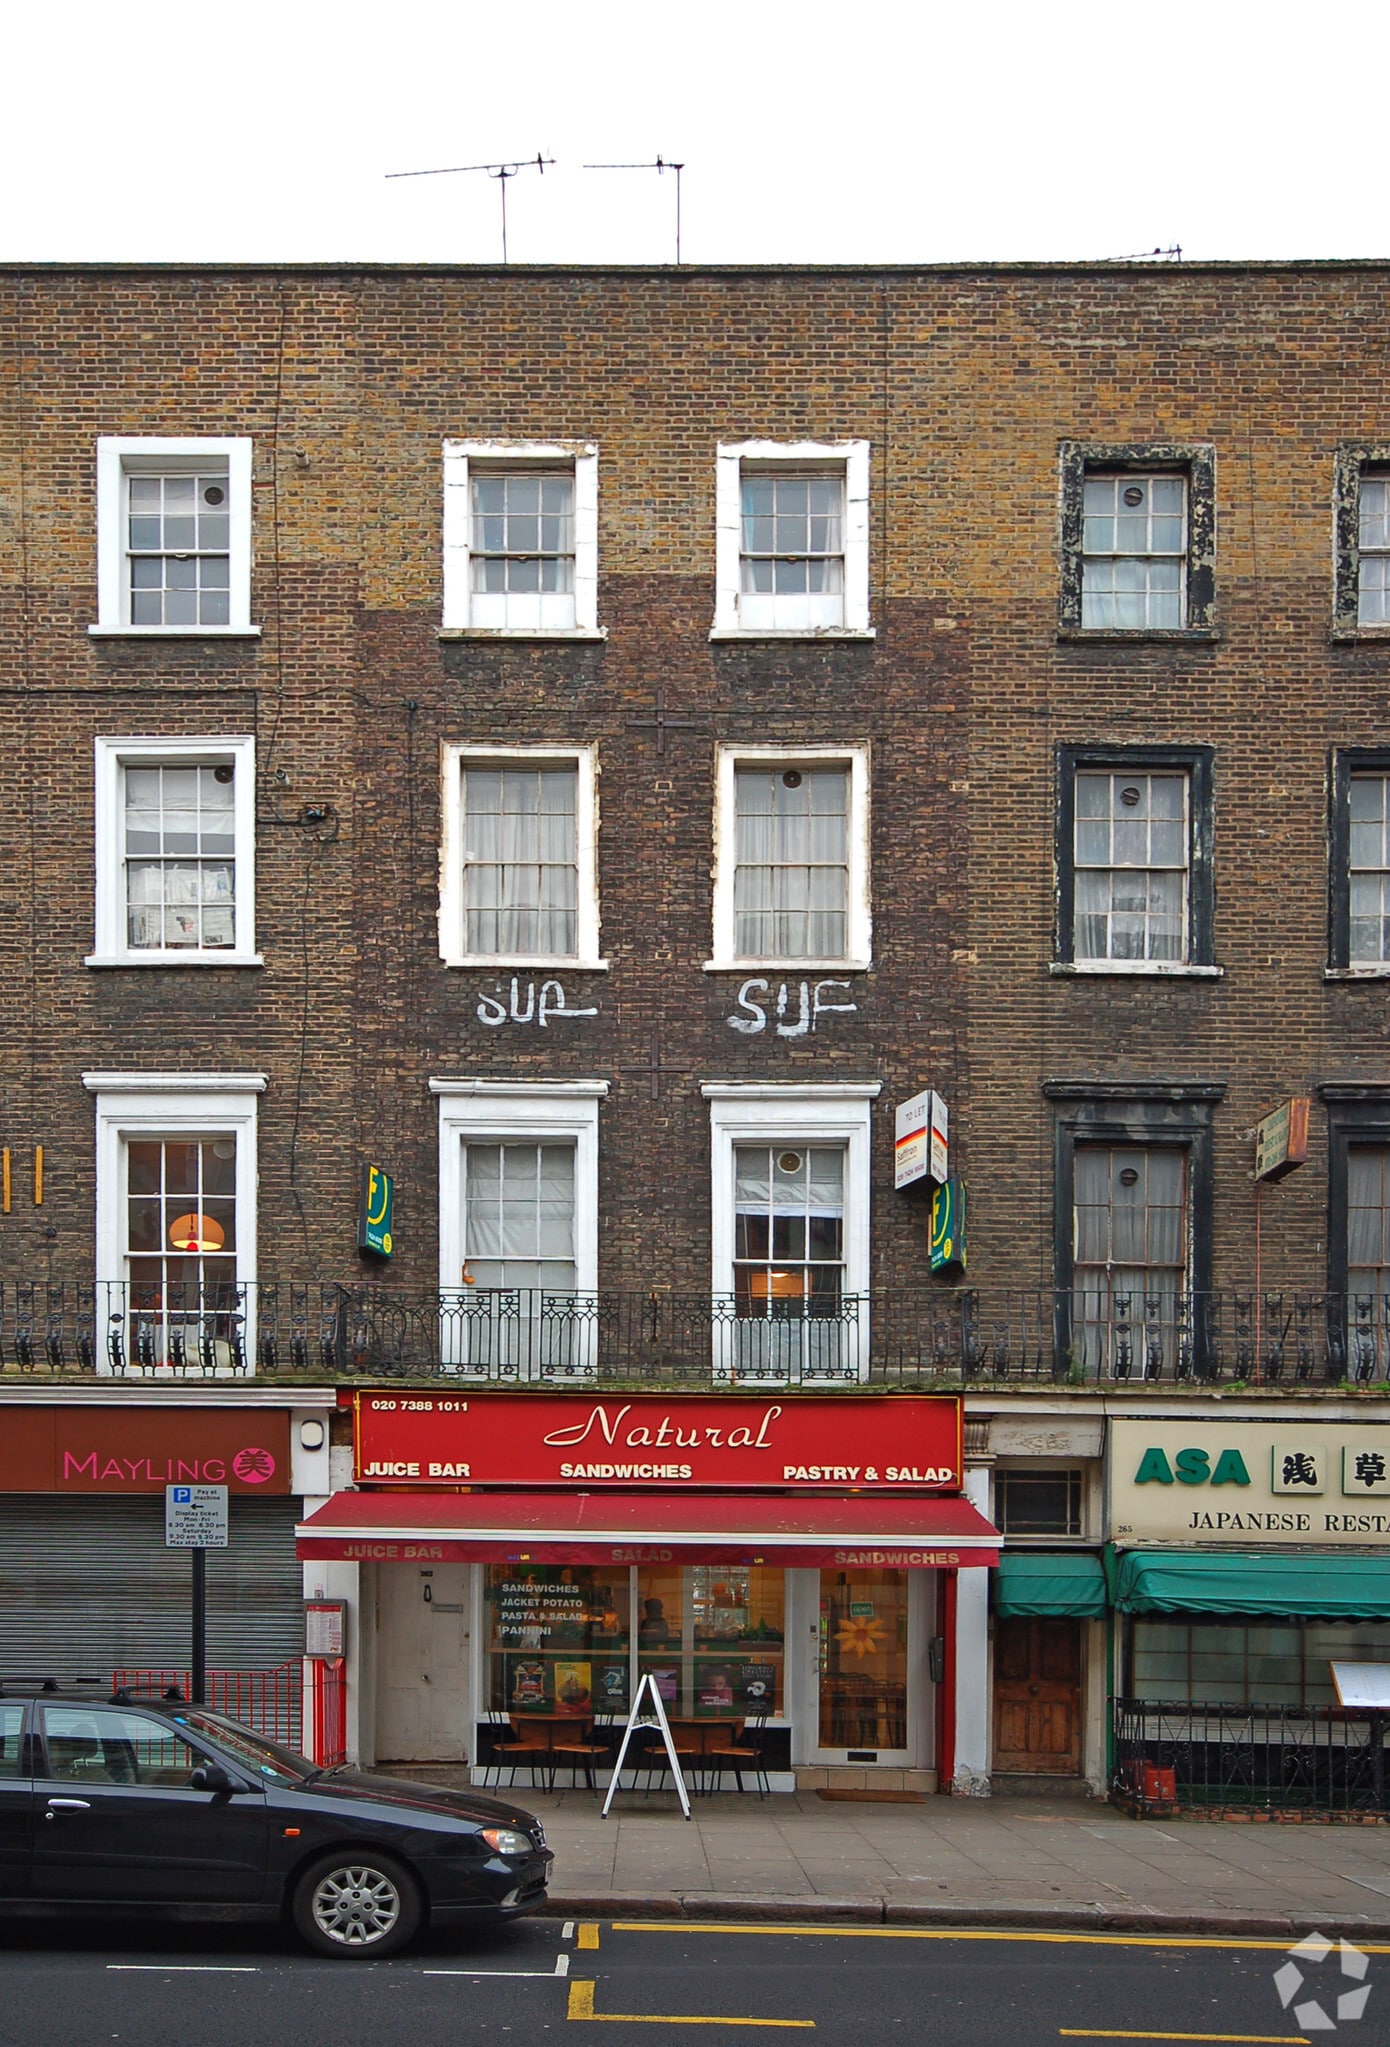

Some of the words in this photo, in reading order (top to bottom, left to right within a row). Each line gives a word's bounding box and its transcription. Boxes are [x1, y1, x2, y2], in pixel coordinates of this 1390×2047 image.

[372, 1401, 396, 1410] 020
[400, 1401, 433, 1411] 7388
[437, 1402, 468, 1411] 1011
[543, 1404, 782, 1448] Natural
[364, 1462, 420, 1476] JUICE
[428, 1463, 470, 1477] BAR
[560, 1463, 692, 1479] SANDWICHES
[1134, 1448, 1251, 1484] ASA
[783, 1465, 861, 1481] PASTRY
[865, 1467, 879, 1481] &
[885, 1467, 953, 1482] SALAD
[178, 1489, 188, 1501] P
[1189, 1512, 1310, 1531] JAPANESE
[1118, 1525, 1133, 1533] 265
[343, 1545, 398, 1557] JUICE
[404, 1546, 442, 1558] BAR
[611, 1549, 673, 1561] SALAD
[834, 1551, 960, 1565] SANDWICHES
[502, 1583, 579, 1593] SANDWICHES
[501, 1598, 540, 1606] JACKET
[543, 1599, 583, 1607] POTATO
[501, 1612, 535, 1620] PASTA
[549, 1612, 583, 1621] SALAD
[502, 1626, 551, 1635] PANNINI
